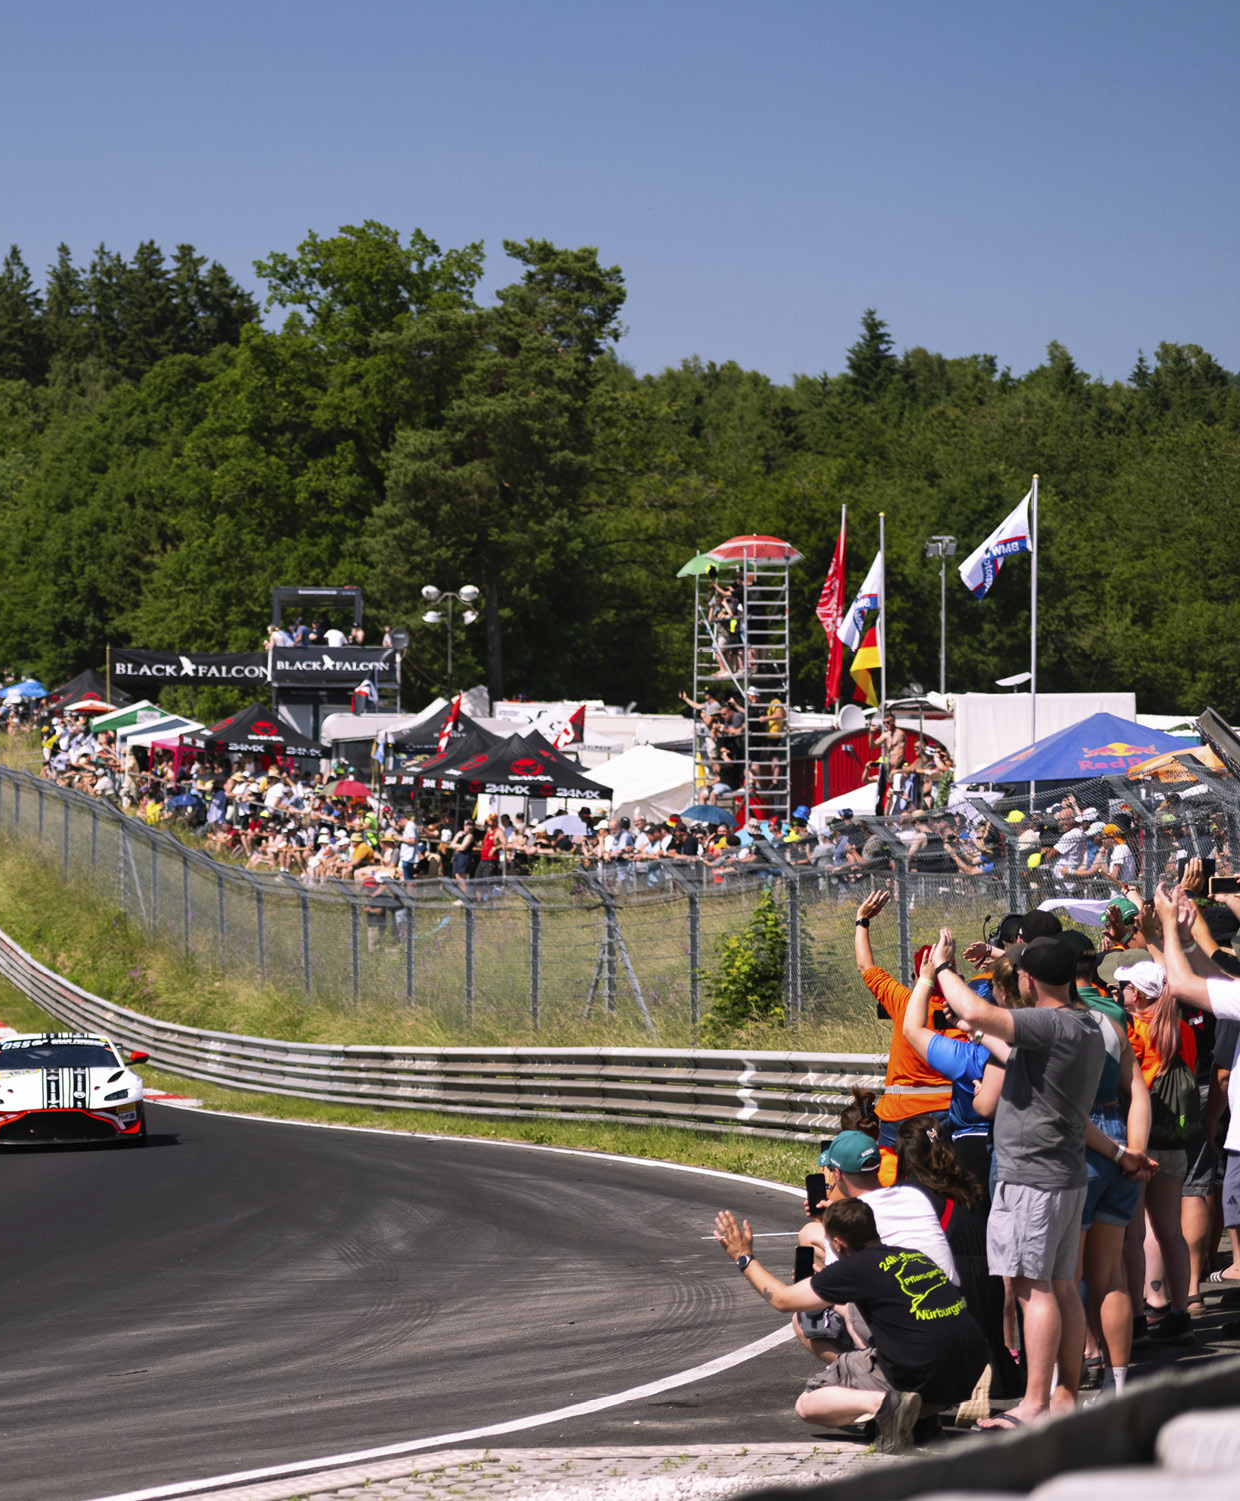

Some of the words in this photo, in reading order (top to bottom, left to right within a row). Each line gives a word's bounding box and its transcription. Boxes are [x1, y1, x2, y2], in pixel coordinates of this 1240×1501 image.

[115, 663, 179, 678] BLACK
[197, 665, 268, 678] FALCON
[276, 660, 322, 671] BLACK
[333, 661, 389, 671] FALCON
[228, 742, 265, 753] 24MX
[285, 746, 322, 757] 24MX
[1077, 758, 1125, 770] Red
[485, 783, 531, 795] 24MX
[556, 787, 601, 799] 24MX
